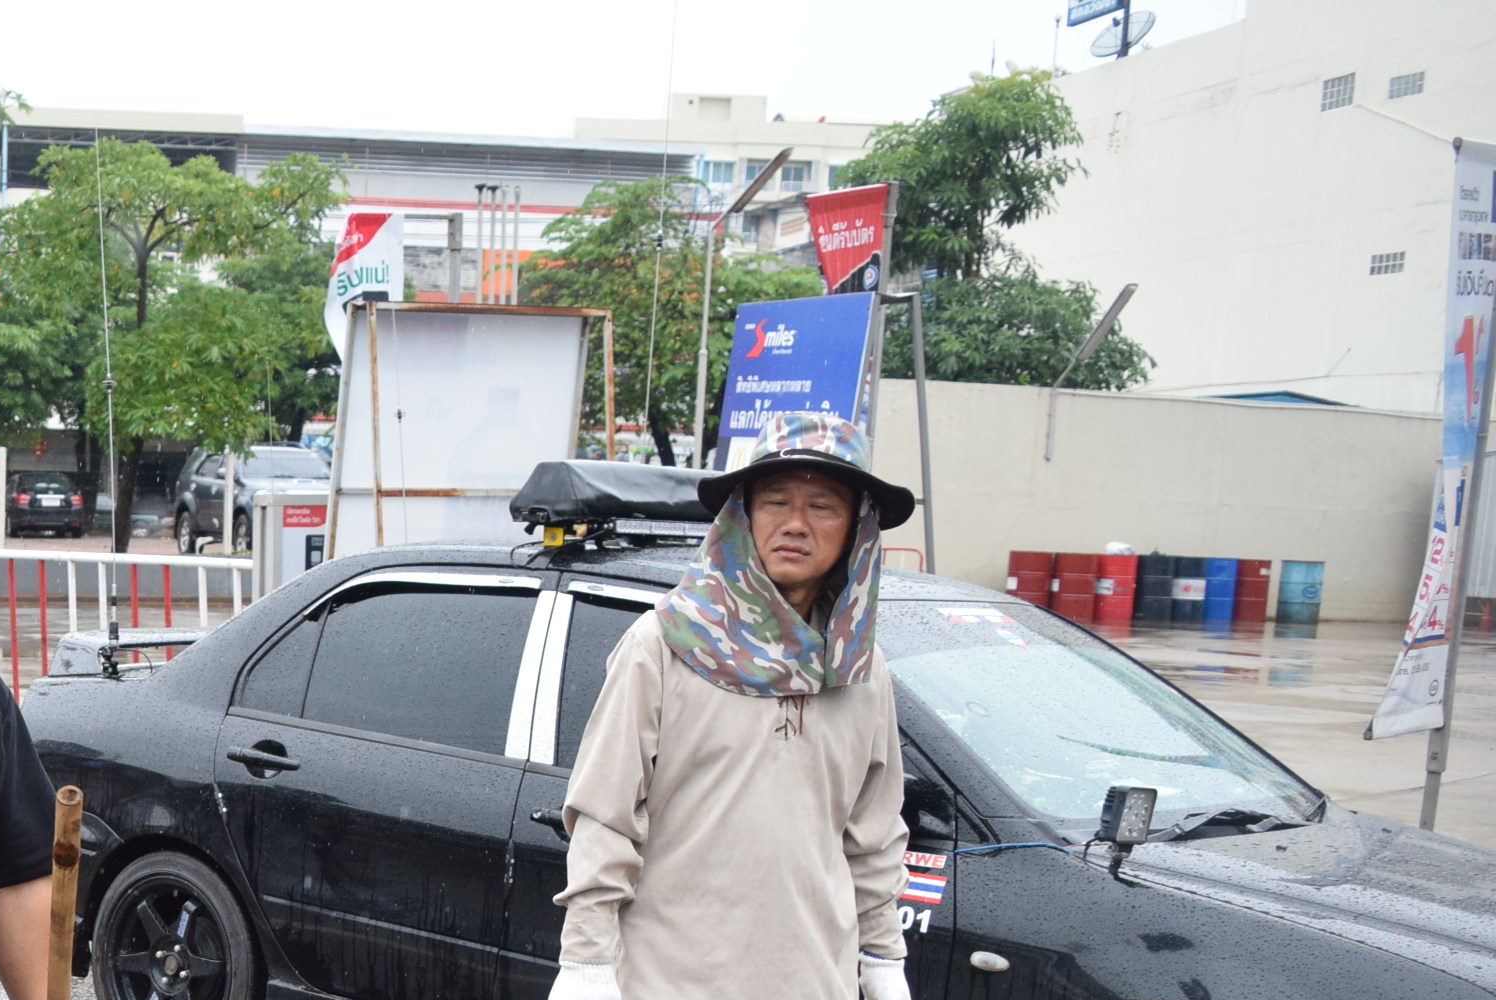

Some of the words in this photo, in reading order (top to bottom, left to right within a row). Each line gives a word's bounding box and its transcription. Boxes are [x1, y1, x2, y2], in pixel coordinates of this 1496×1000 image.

[818, 218, 875, 253] ยินดีรับบัตร
[745, 318, 796, 358] Smiles
[735, 375, 812, 393] สิทธิพิเศษหลากหลาย
[903, 850, 945, 869] RWE
